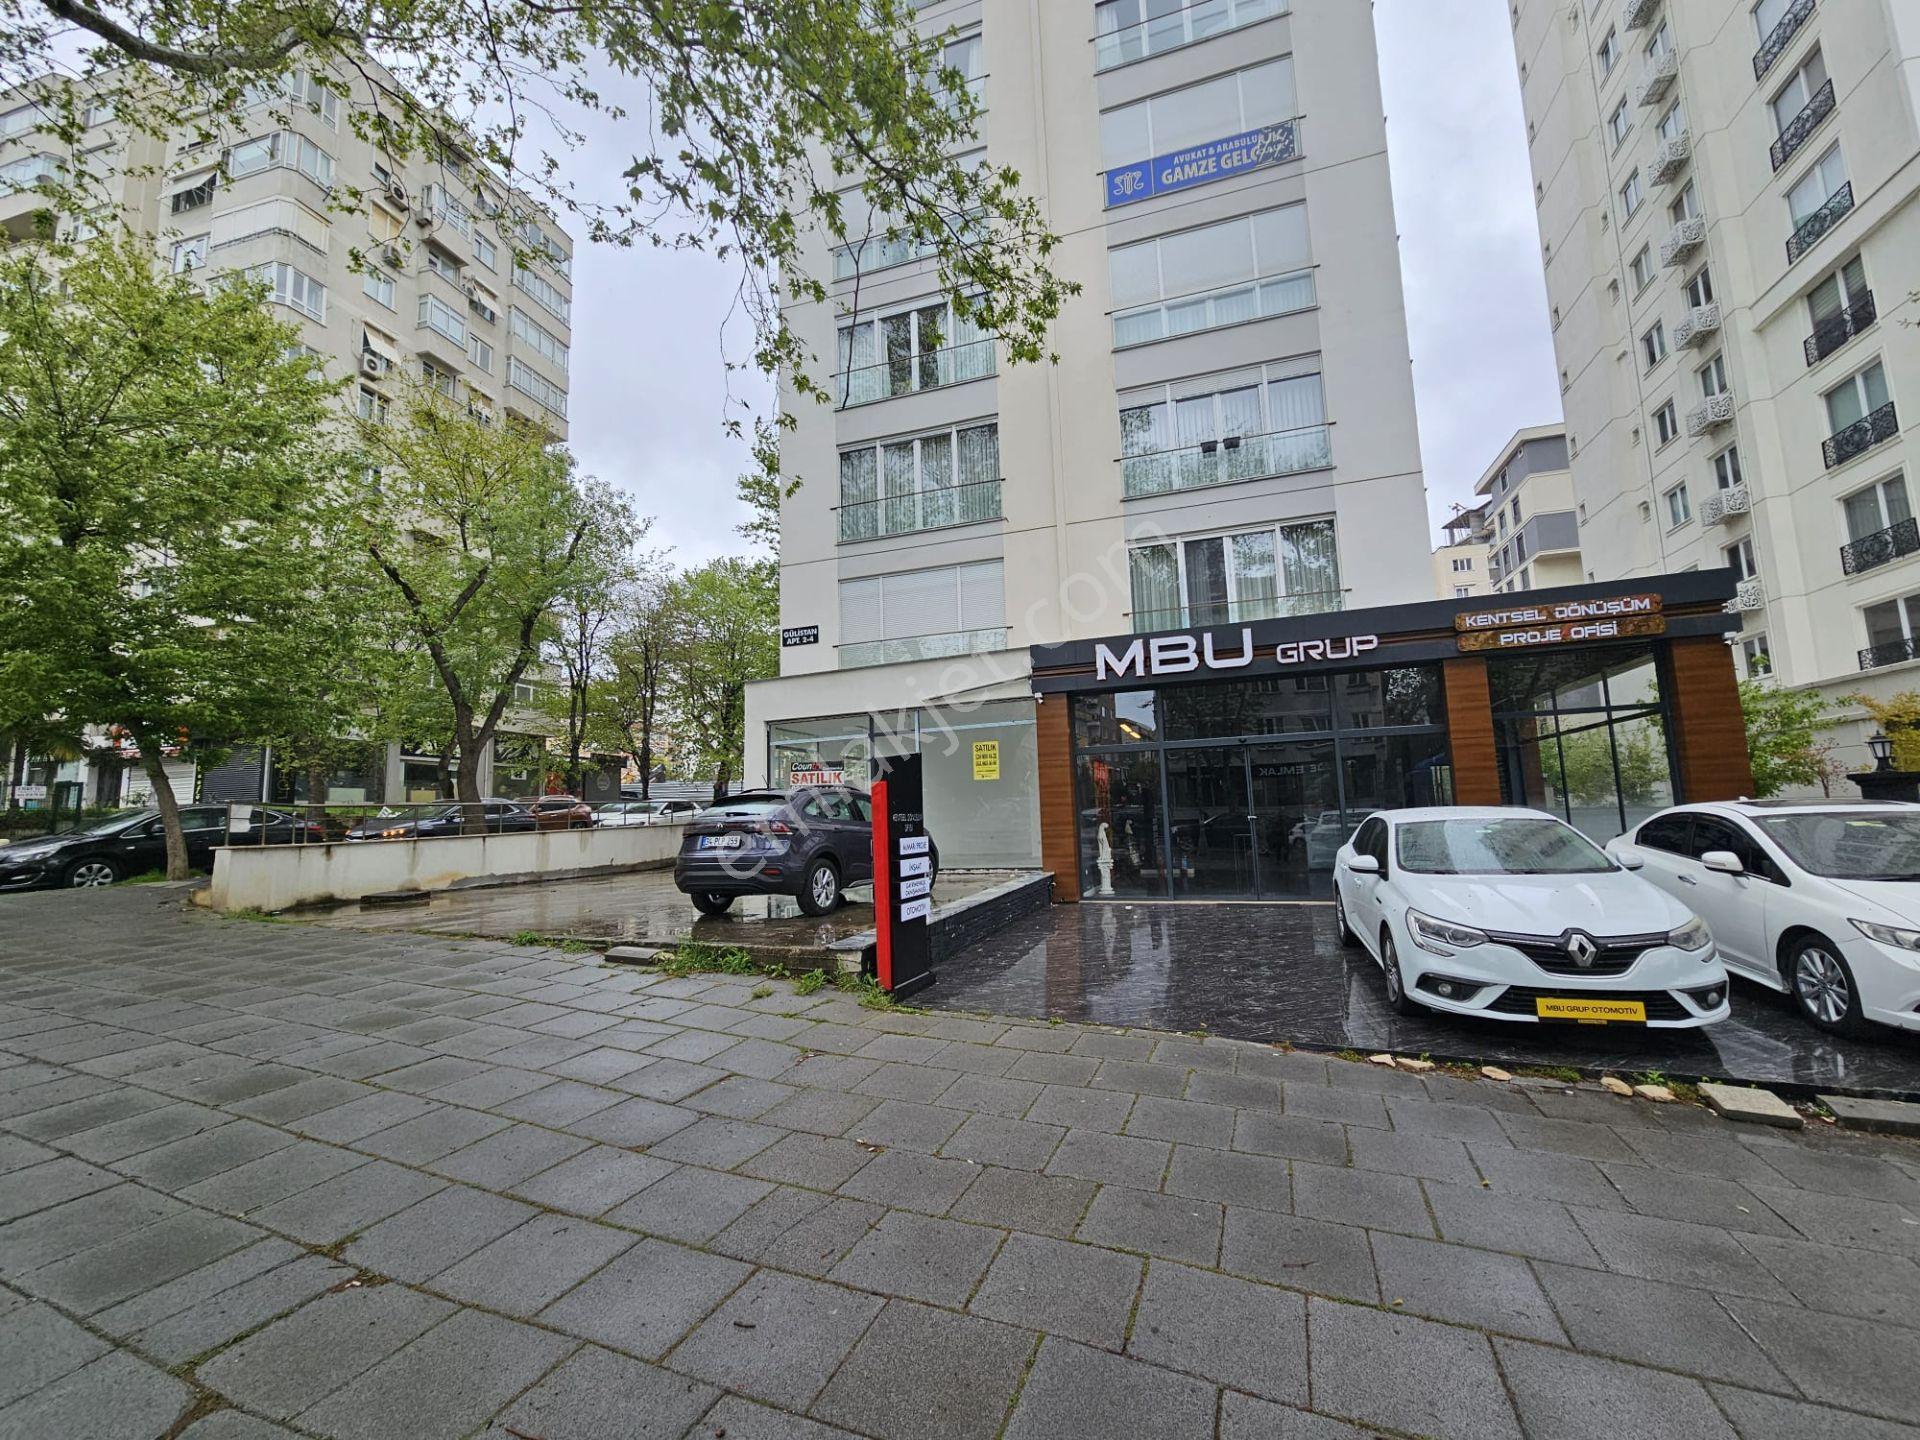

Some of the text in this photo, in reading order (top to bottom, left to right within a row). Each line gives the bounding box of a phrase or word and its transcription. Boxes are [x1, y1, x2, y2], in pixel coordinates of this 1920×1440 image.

[1173, 149, 1207, 165] AVUKAT
[1161, 158, 1217, 185] GAMZE
[1465, 597, 1651, 627] KENTSEL DÖNÜŞÜM
[802, 635, 814, 643] 2-4
[1500, 620, 1618, 646] PROJE OFİSİ
[1095, 628, 1379, 681] MBU GRUP
[974, 743, 997, 752] SATILIK
[791, 772, 842, 784] SATILIK
[1545, 1004, 1638, 1015] MBU GRUP OTOMOTİV
